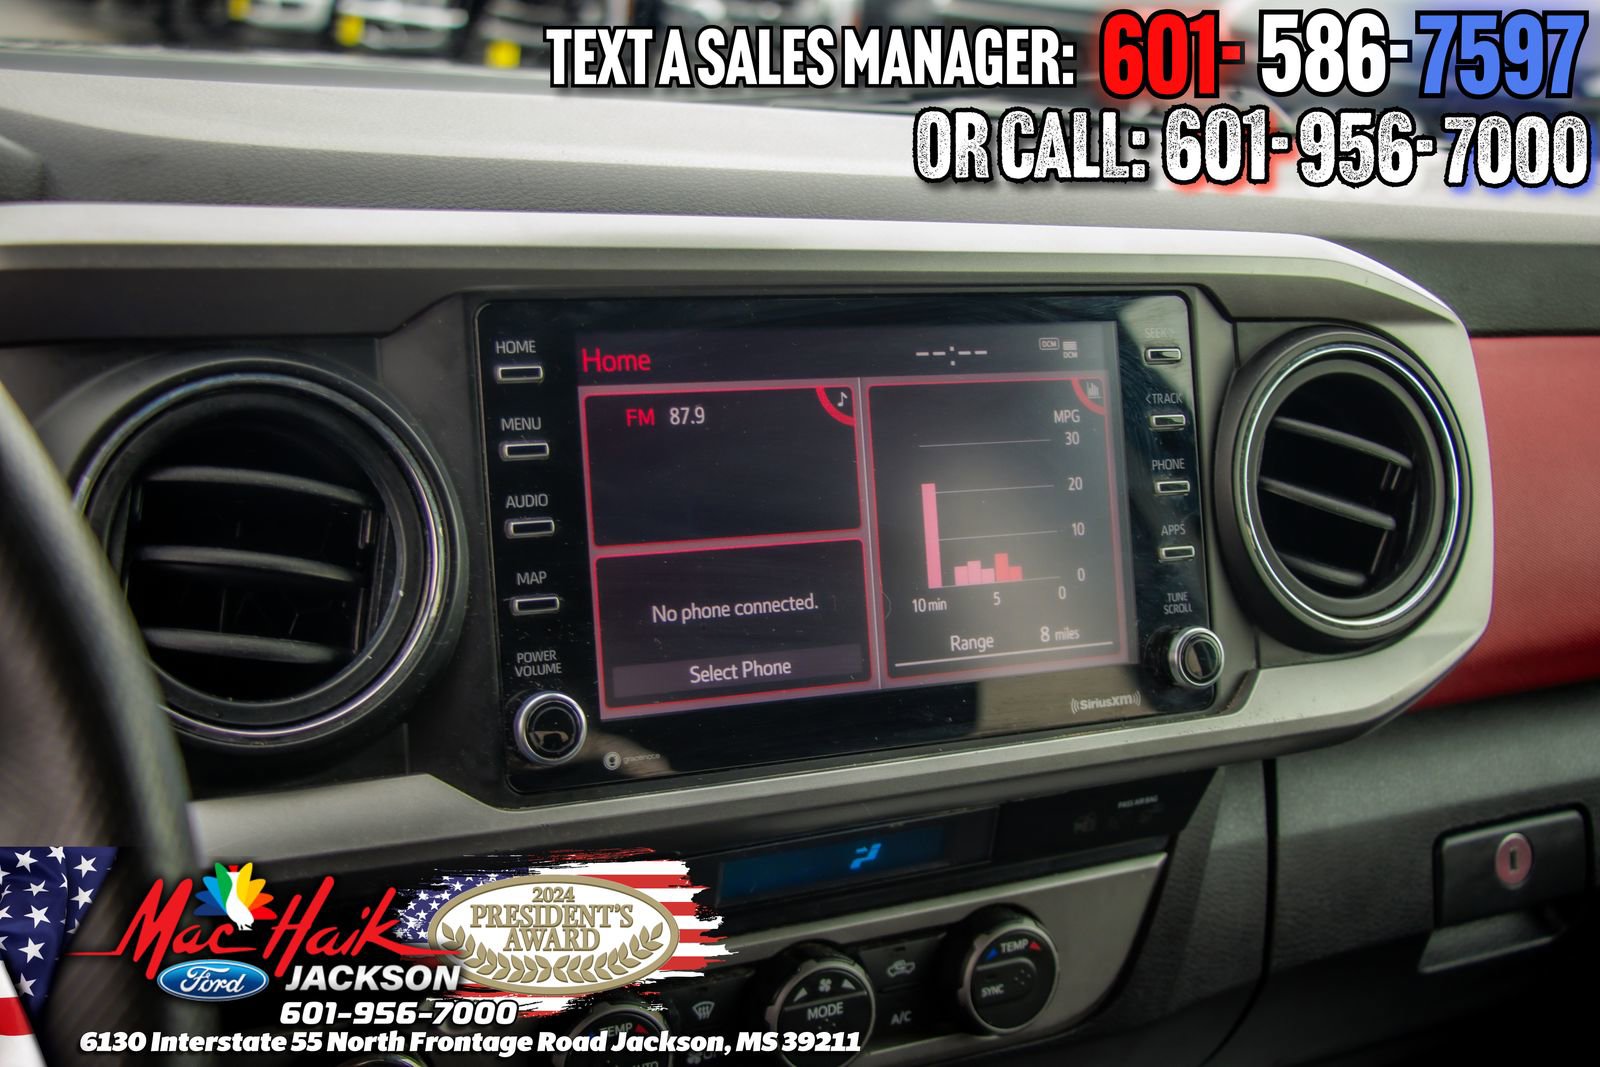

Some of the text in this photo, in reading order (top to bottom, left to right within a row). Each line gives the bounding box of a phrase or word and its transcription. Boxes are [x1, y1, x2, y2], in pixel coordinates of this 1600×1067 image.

[495, 340, 537, 354] HOME
[581, 348, 651, 372] Home
[501, 417, 542, 431] MENU
[625, 406, 705, 427] FM 87.9
[1054, 409, 1080, 424] MPG
[1065, 431, 1080, 446] 30
[1152, 458, 1185, 471] PHONE
[1068, 476, 1083, 491] 20
[505, 493, 549, 509] AUDIO
[1071, 522, 1085, 537] 10
[1161, 523, 1186, 537] APPS
[516, 571, 547, 586] MAP
[1077, 567, 1086, 582] 0
[993, 591, 1001, 606] 5
[1058, 586, 1066, 600] 0
[1167, 592, 1188, 602] TUNE
[652, 593, 819, 624] No phone connected.
[912, 597, 947, 613] 10 min
[1163, 603, 1192, 614] SCROLL
[951, 626, 1080, 652] Range 8 miles
[516, 650, 557, 664] POWER
[514, 663, 562, 677] VOLUME
[689, 660, 792, 684] Select Phone
[1001, 939, 1029, 954] TEMP
[981, 984, 1005, 998] SYNC
[807, 1002, 844, 1021] MODE
[891, 1010, 912, 1026] A/C
